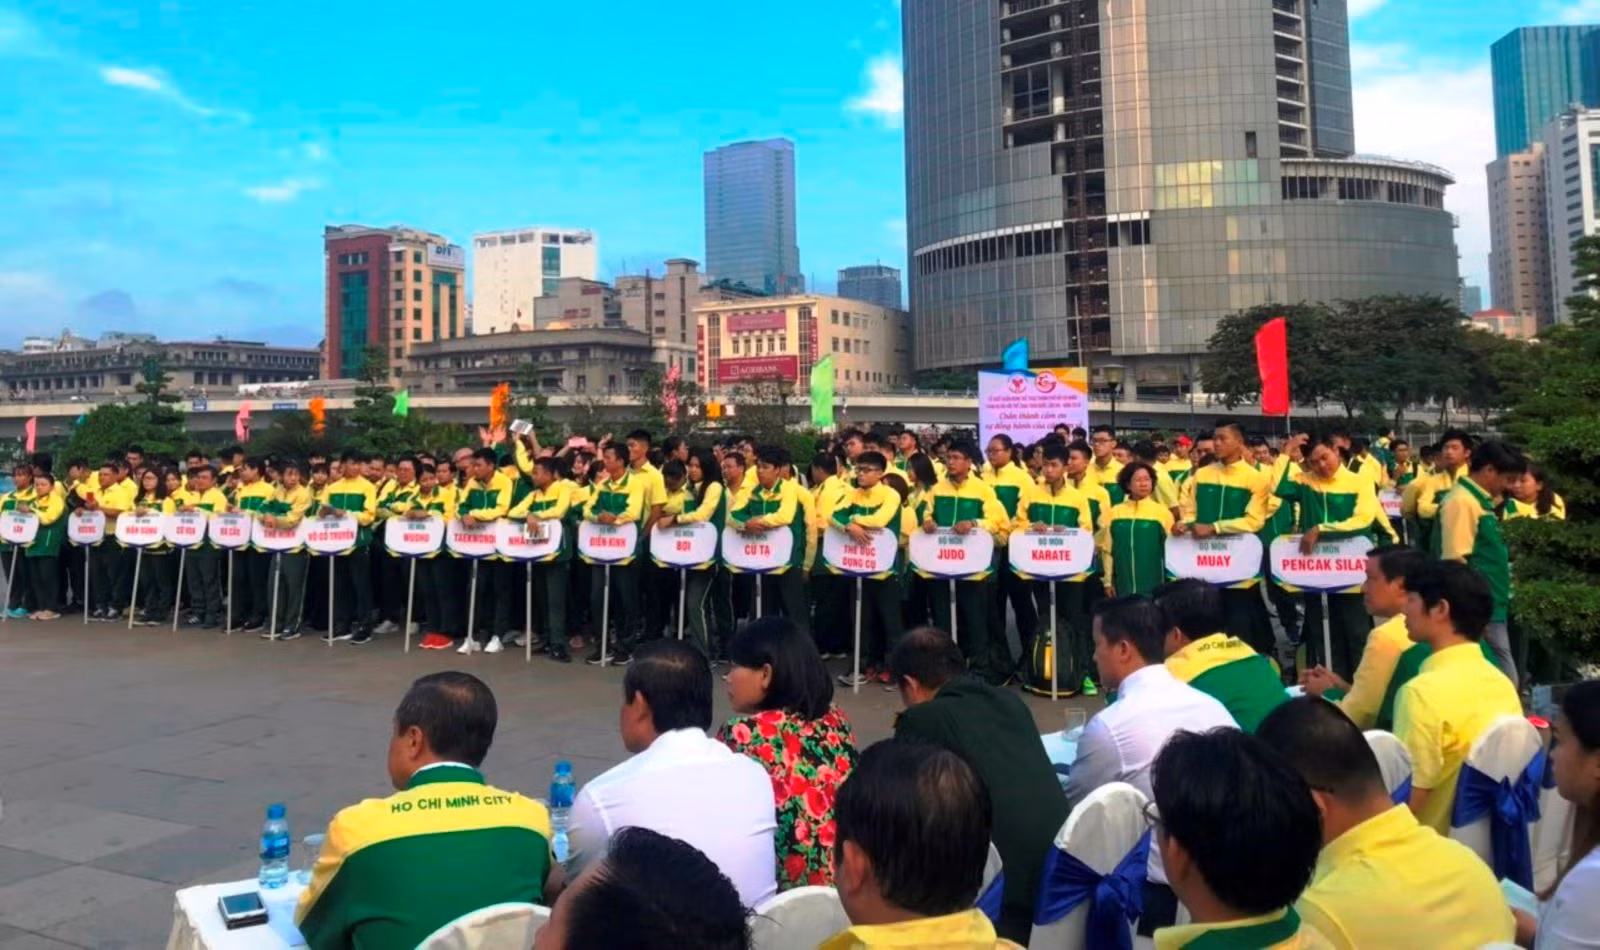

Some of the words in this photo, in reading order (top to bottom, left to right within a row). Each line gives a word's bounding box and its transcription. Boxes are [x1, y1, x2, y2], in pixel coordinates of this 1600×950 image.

[454, 533, 496, 544] TAEKWOND
[937, 549, 965, 560] JUDO
[1031, 549, 1071, 561] KARATE
[1196, 555, 1231, 567] MUAY
[1282, 558, 1331, 571] PENCAK
[391, 801, 413, 813] HO
[417, 798, 442, 810] CHI
[445, 795, 480, 808] MINH
[483, 795, 512, 805] CITY
